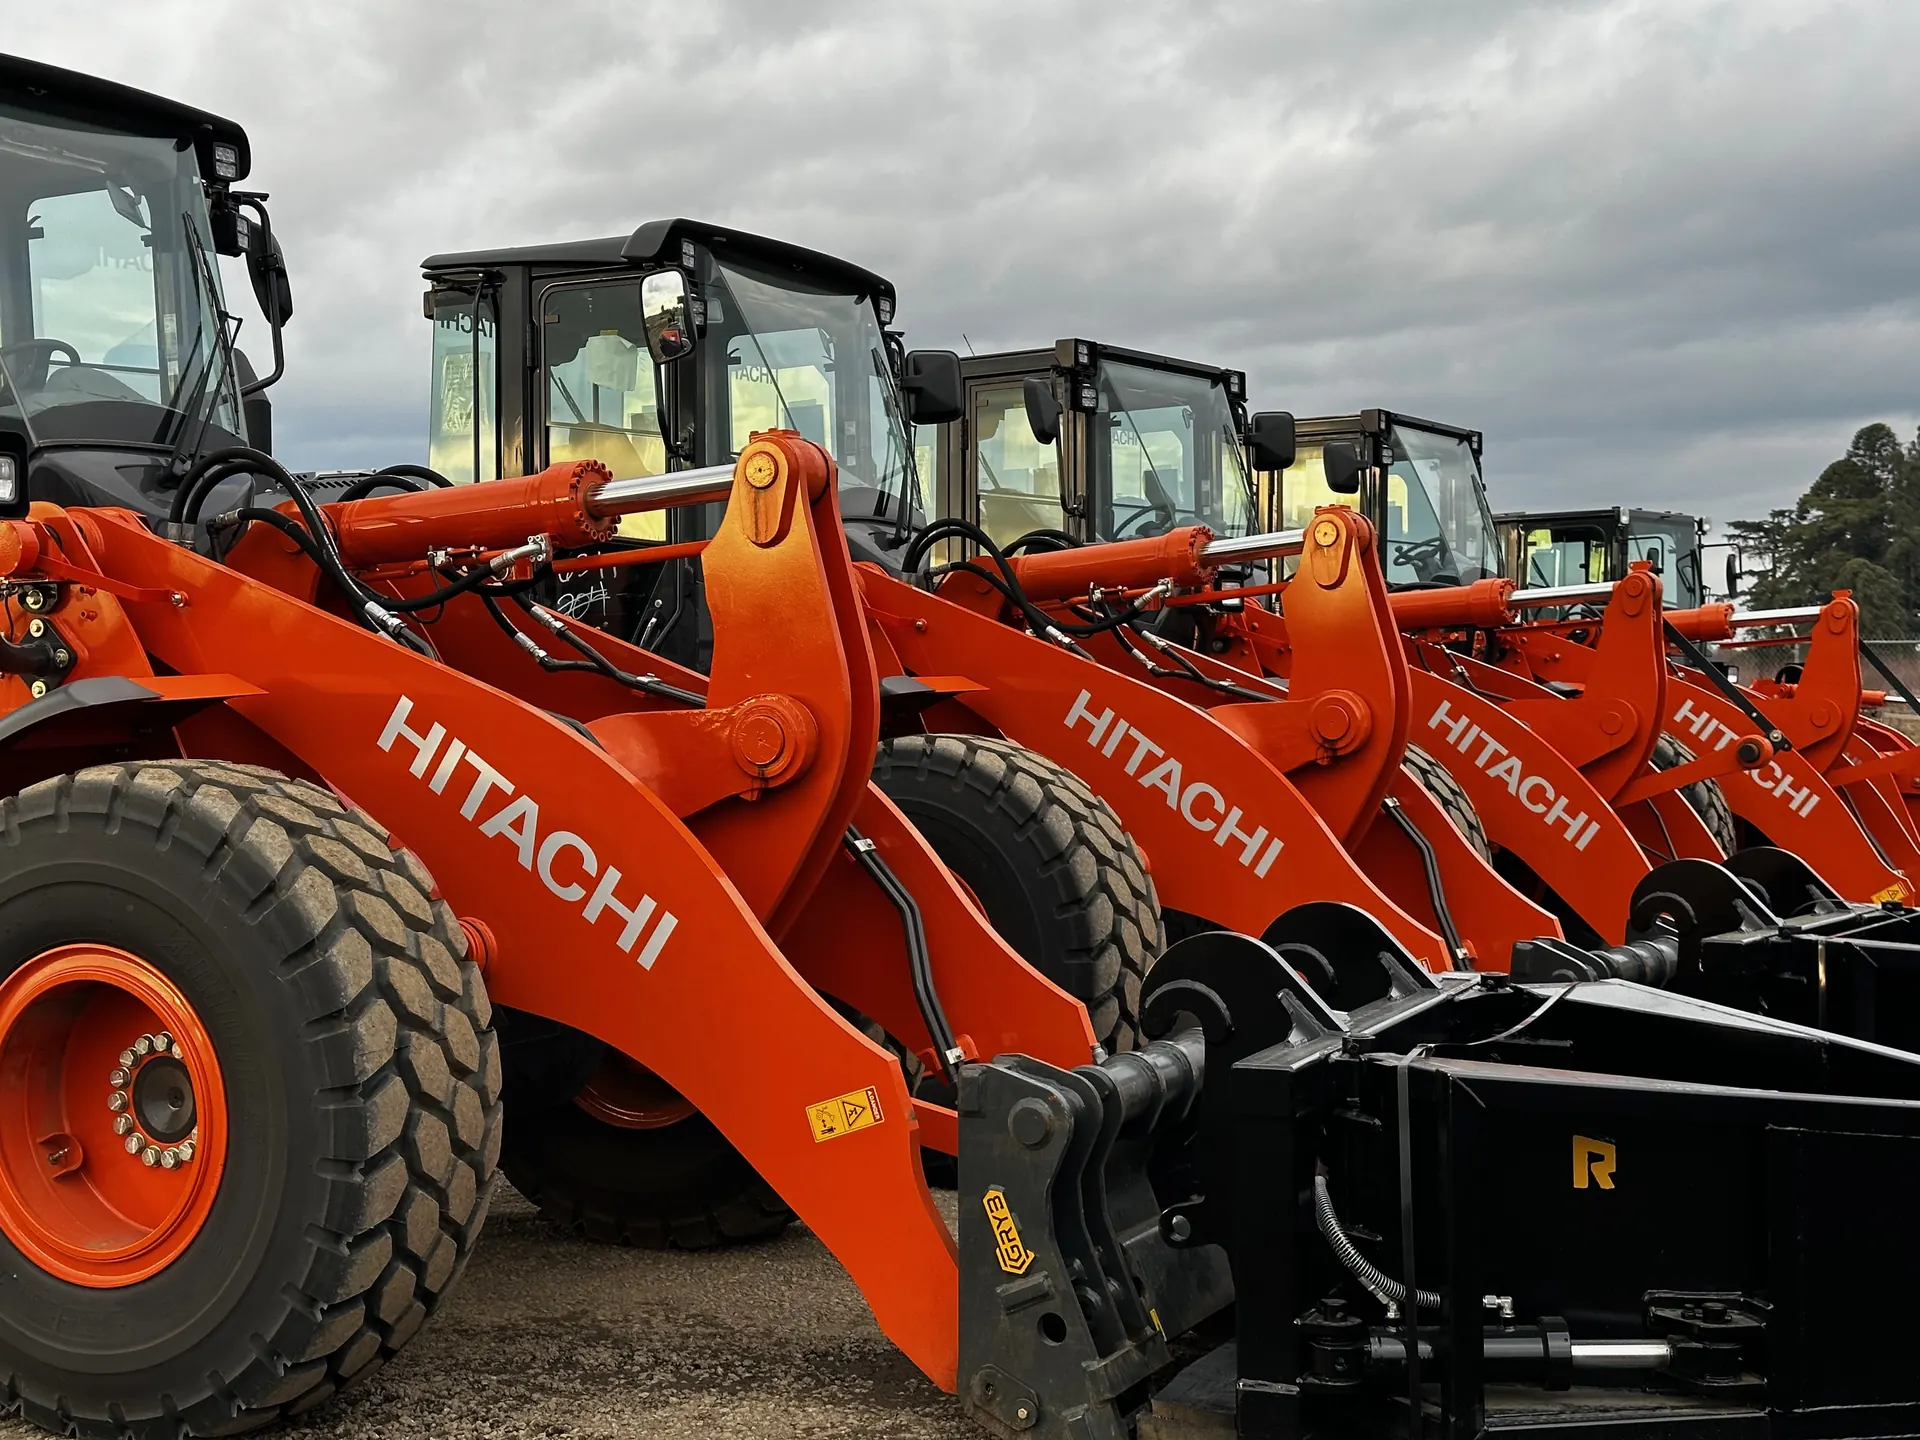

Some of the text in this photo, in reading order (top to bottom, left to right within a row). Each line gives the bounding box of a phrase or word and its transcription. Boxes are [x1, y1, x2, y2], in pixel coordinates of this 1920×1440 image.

[734, 366, 772, 384] TACH
[1064, 690, 1283, 877] HITACHI
[1429, 701, 1600, 850] HITACHI
[1674, 699, 1820, 818] HITCHI
[377, 696, 678, 969] HITACHI
[1573, 1136, 1616, 1190] R
